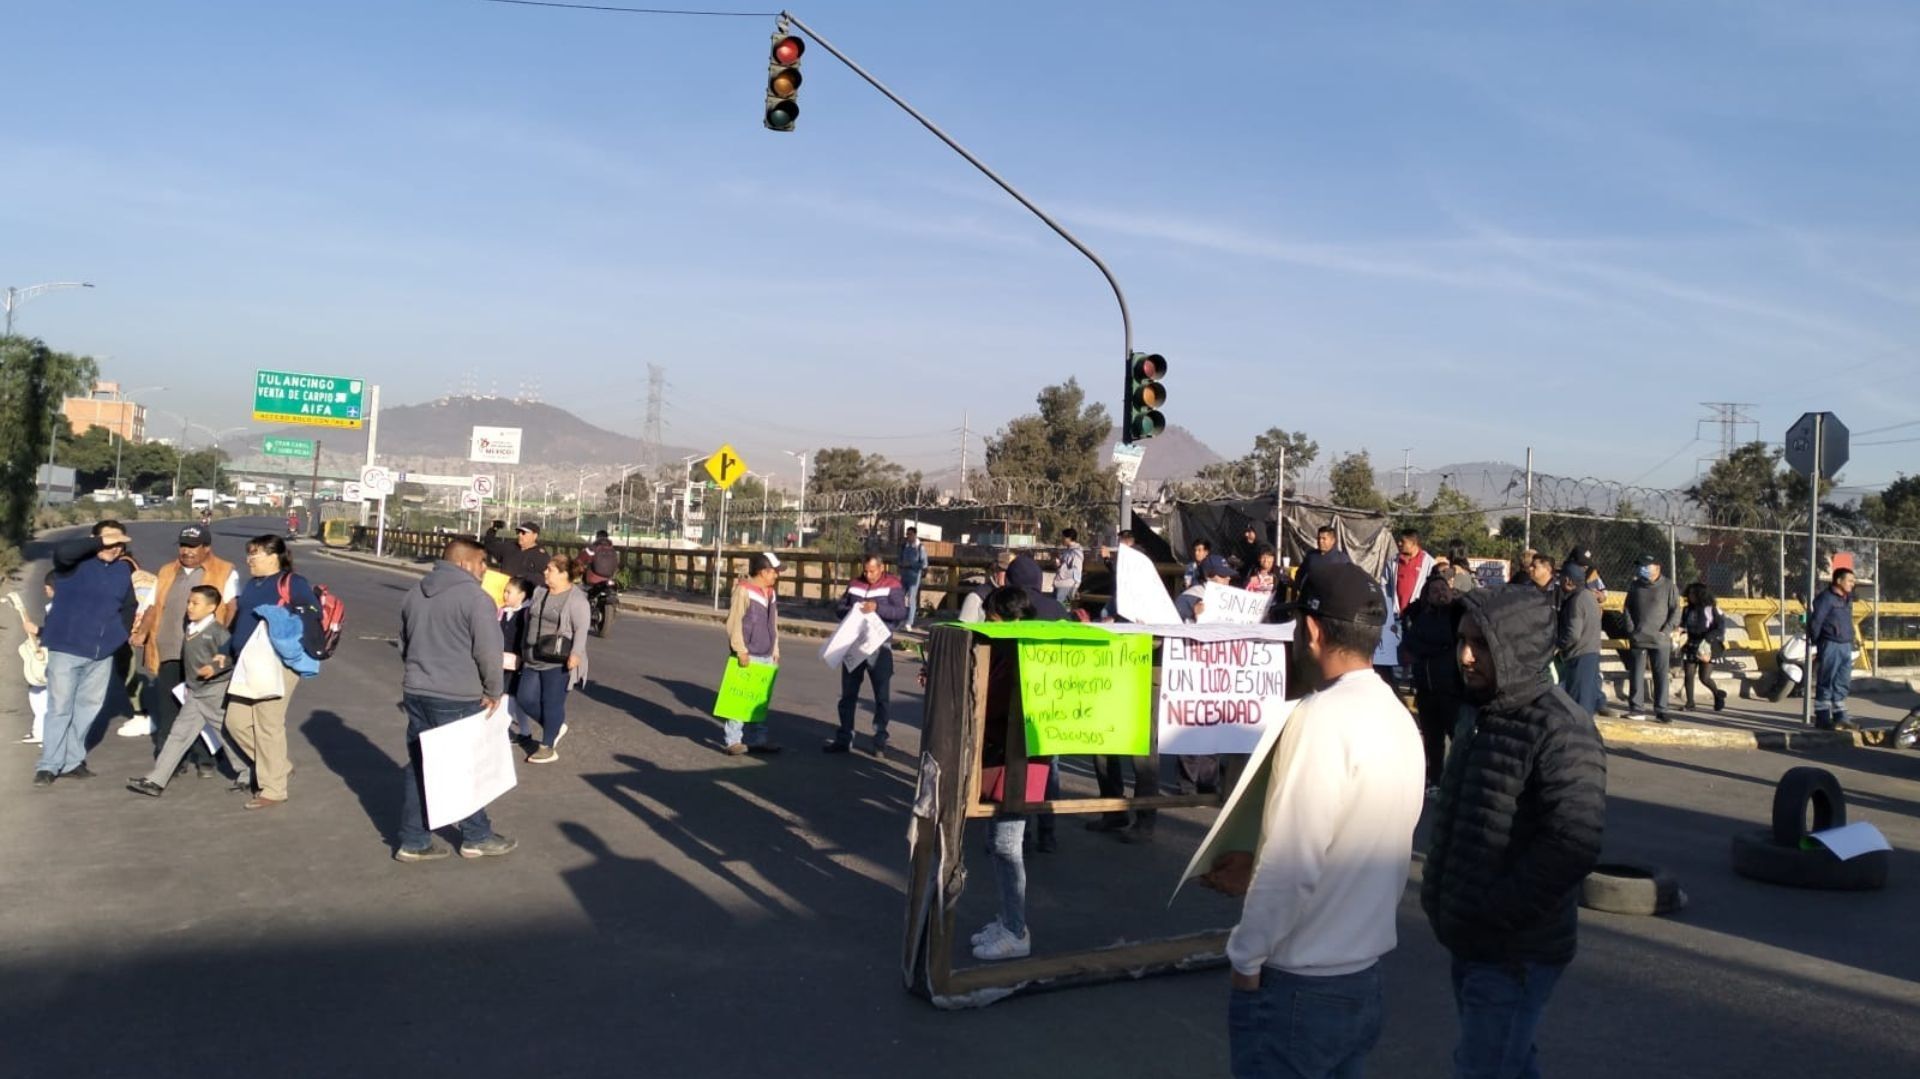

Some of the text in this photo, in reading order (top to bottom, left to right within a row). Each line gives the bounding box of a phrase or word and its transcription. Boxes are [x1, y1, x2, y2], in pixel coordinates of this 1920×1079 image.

[260, 374, 334, 390] TULANCINGO
[258, 386, 333, 403] VENTA DE CARPIO
[301, 403, 332, 415] AIFA
[1219, 591, 1247, 614] SIN
[1034, 672, 1047, 696] el
[1168, 669, 1194, 692] UN
[1234, 669, 1255, 694] ES
[1255, 670, 1284, 698] UNA
[1072, 702, 1094, 719] de
